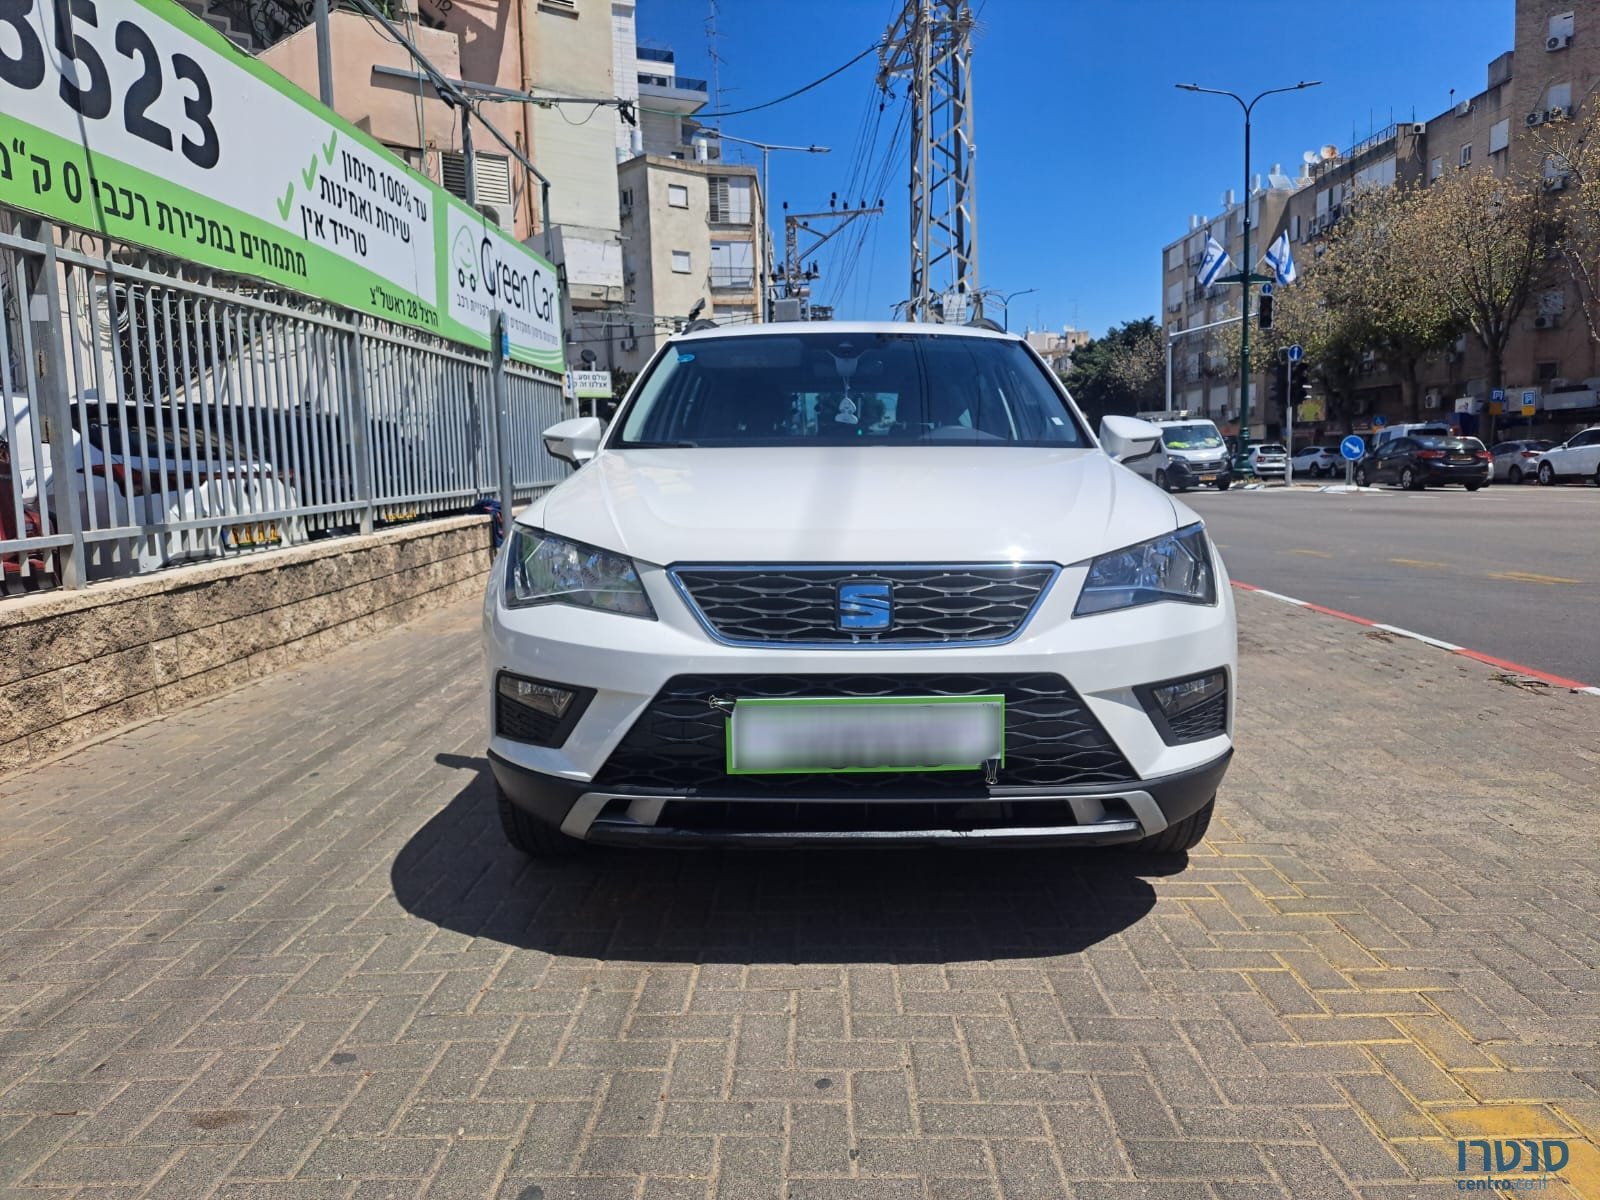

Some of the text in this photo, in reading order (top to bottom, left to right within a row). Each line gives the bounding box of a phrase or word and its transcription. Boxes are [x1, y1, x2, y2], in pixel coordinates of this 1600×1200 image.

[63, 161, 82, 203] 0
[91, 177, 150, 226] רכבי
[342, 150, 428, 222] עד 100% מימון
[156, 200, 236, 254] במכירת
[301, 204, 367, 257] טרייד אין
[320, 174, 410, 243] שירות ואמינות
[240, 230, 307, 277] מתמחים
[481, 236, 554, 325] Green Car
[407, 299, 418, 319] 28
[419, 302, 439, 327] הרצל
